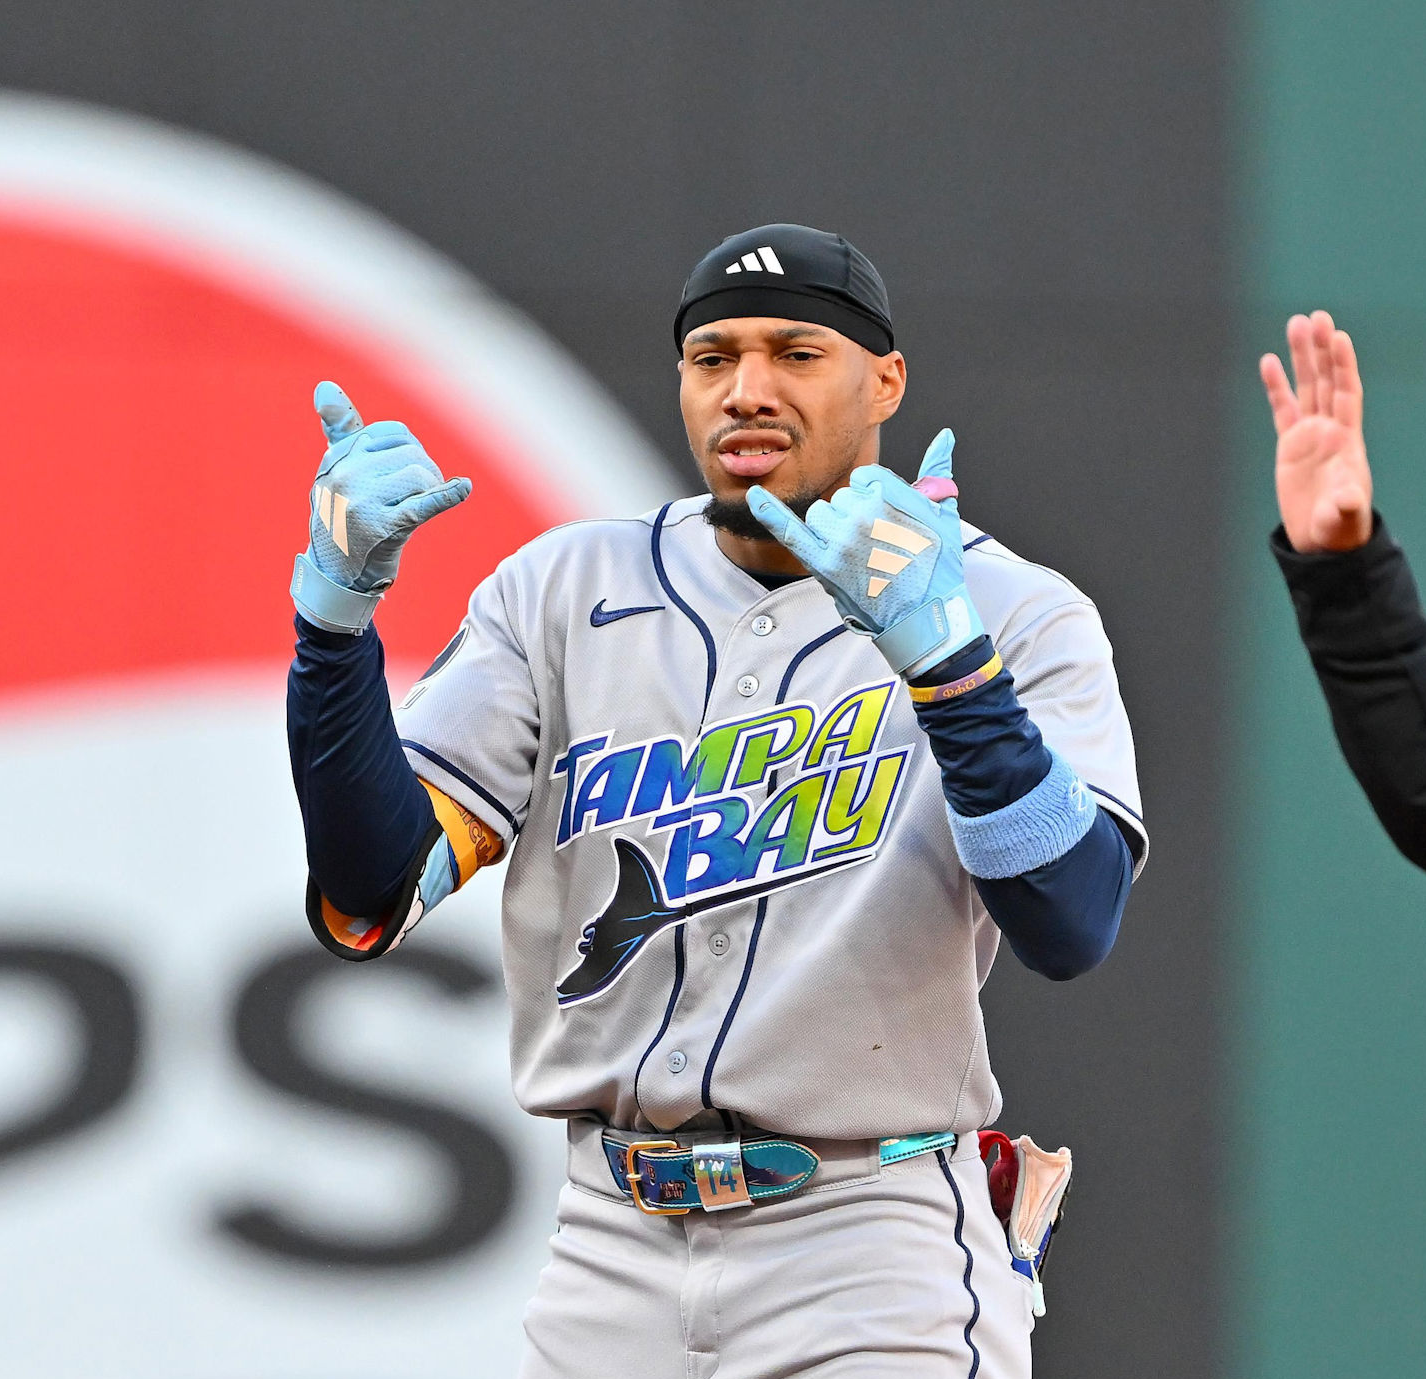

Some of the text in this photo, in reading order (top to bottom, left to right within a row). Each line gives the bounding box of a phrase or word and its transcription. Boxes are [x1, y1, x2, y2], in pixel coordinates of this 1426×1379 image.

[550, 681, 901, 850] TAMPA
[651, 743, 915, 904] BAY
[705, 1158, 737, 1195] 14
